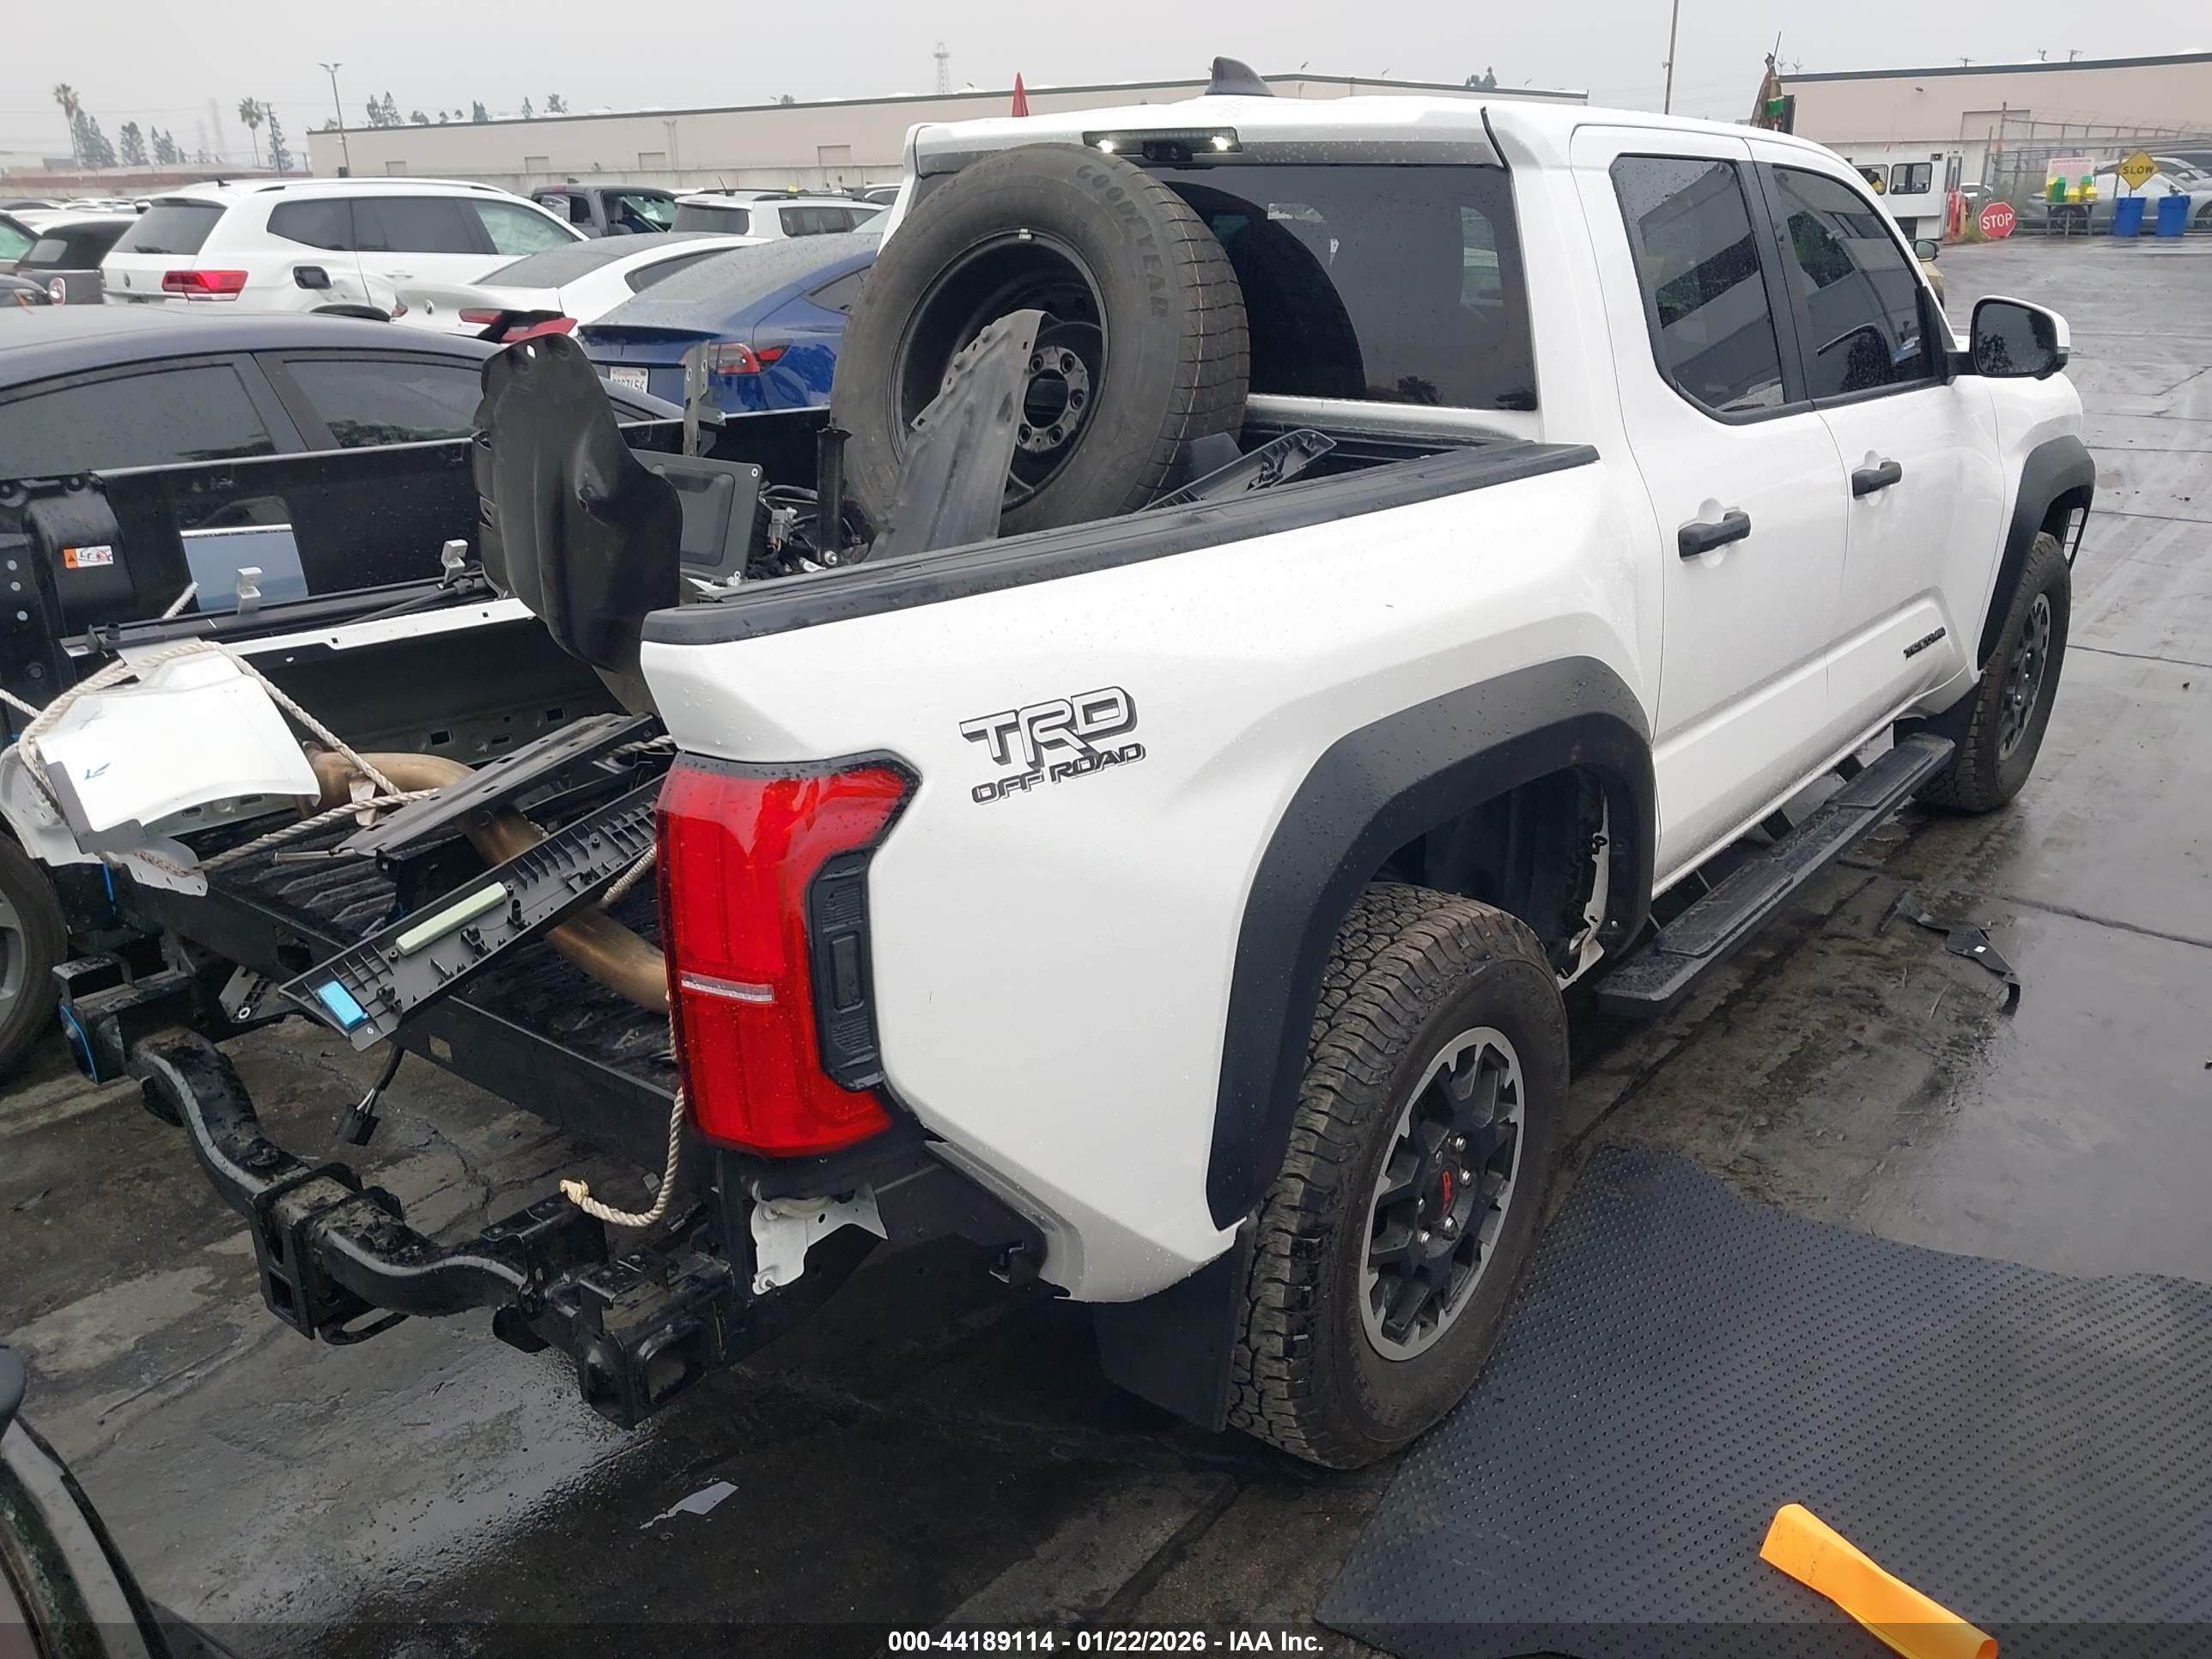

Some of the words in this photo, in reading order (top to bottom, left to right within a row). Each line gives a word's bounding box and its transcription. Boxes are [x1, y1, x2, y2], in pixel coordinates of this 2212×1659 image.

[2123, 166, 2154, 175] SLOW
[1076, 165, 1169, 318] GOODYEAR
[1982, 213, 2013, 230] STOP
[959, 686, 1138, 771] TRD
[971, 769, 1045, 805] OFF
[1049, 743, 1146, 784] ROAD
